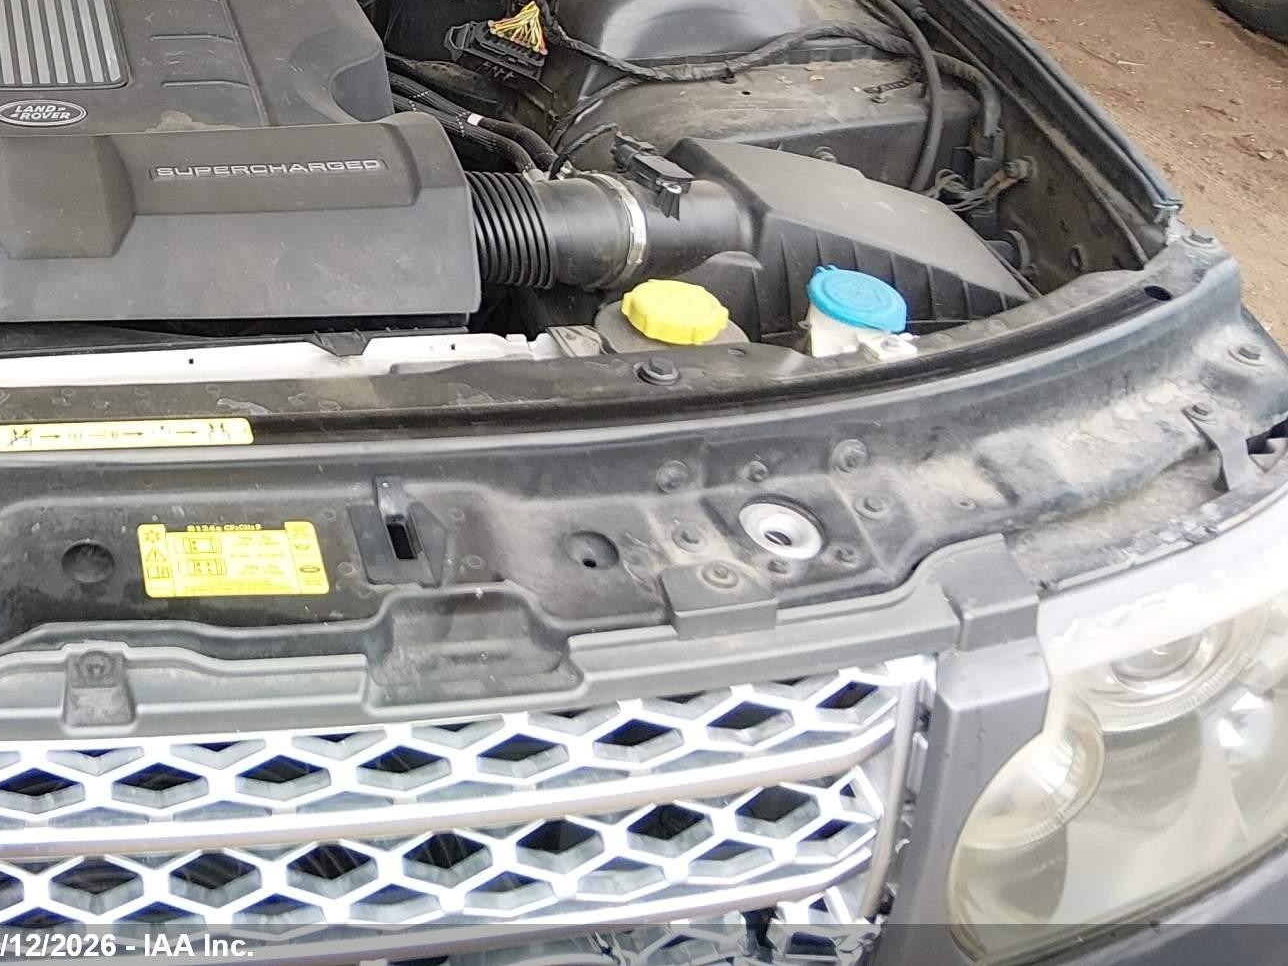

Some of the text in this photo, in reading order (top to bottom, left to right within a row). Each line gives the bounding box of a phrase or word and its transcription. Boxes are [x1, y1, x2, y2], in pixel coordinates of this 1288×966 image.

[14, 105, 57, 113] LAND
[19, 112, 71, 120] ROVER
[155, 159, 382, 177] SUPERCHARGED
